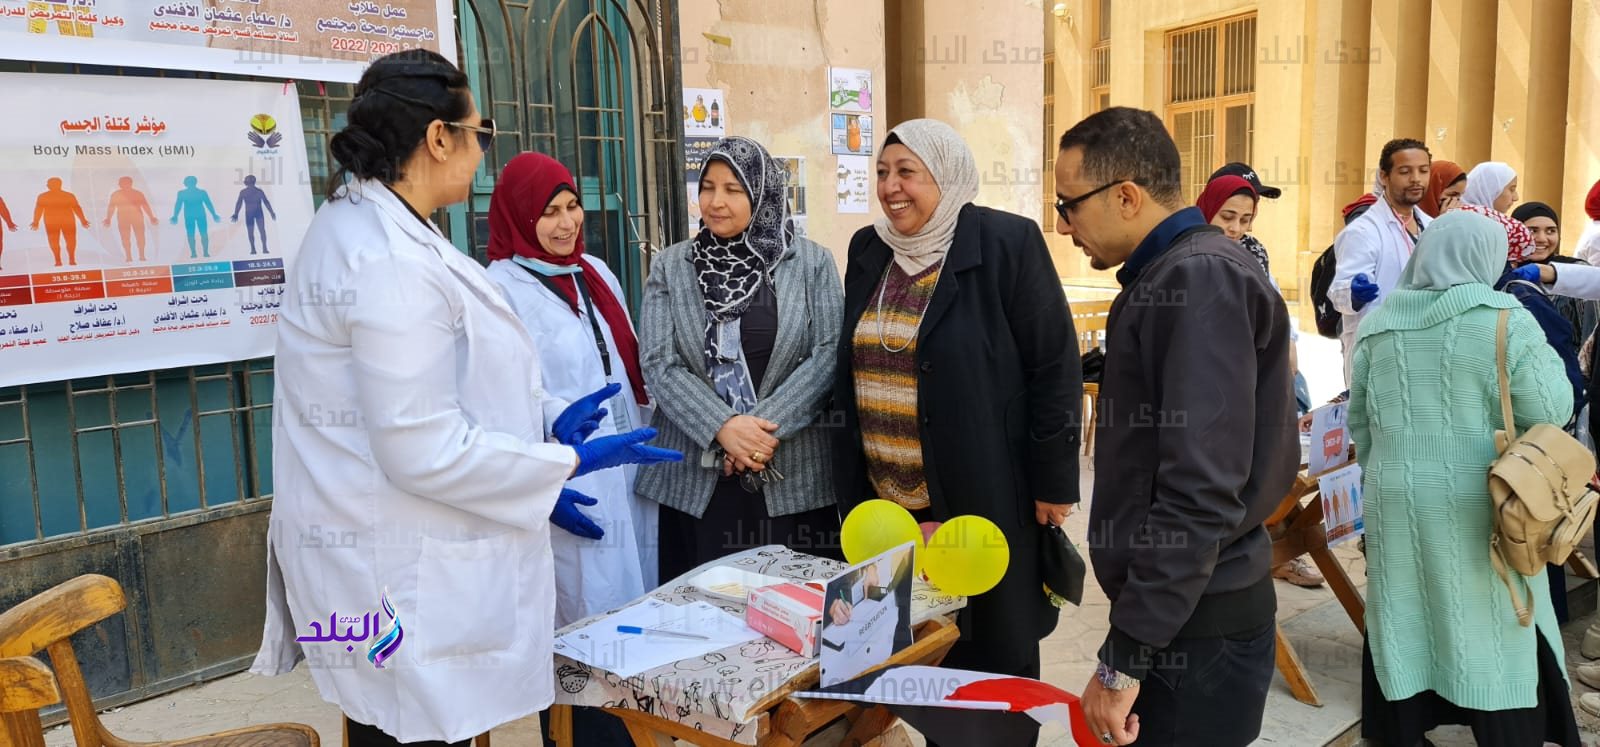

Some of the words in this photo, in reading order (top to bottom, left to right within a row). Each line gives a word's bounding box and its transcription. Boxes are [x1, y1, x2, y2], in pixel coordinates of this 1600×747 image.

[29, 8, 75, 20] التمريض
[350, 1, 379, 14] طلاب
[383, 5, 406, 17] عمل
[77, 12, 98, 24] كلية
[102, 15, 125, 26] وكيل
[204, 8, 242, 22] عثمان
[247, 10, 277, 28] علياء
[149, 20, 178, 31] مجتمع
[179, 21, 200, 32] صحة
[316, 17, 357, 32] مجتمع
[360, 19, 388, 34] صحة
[391, 25, 434, 40] ماجستير
[371, 41, 400, 54] 2021
[60, 115, 101, 135] الجسم
[105, 114, 130, 131] كتلة
[135, 116, 166, 135] مؤشر
[33, 144, 70, 158] Body
[75, 144, 112, 156] Mass
[117, 144, 154, 156] Index
[159, 145, 195, 158] (BMI)
[190, 294, 208, 304] تحت
[98, 302, 118, 312] تحت
[240, 302, 264, 314] مجتمع
[179, 309, 200, 321] عثمان
[69, 320, 90, 334] صلاح
[92, 318, 112, 328] عفاف
